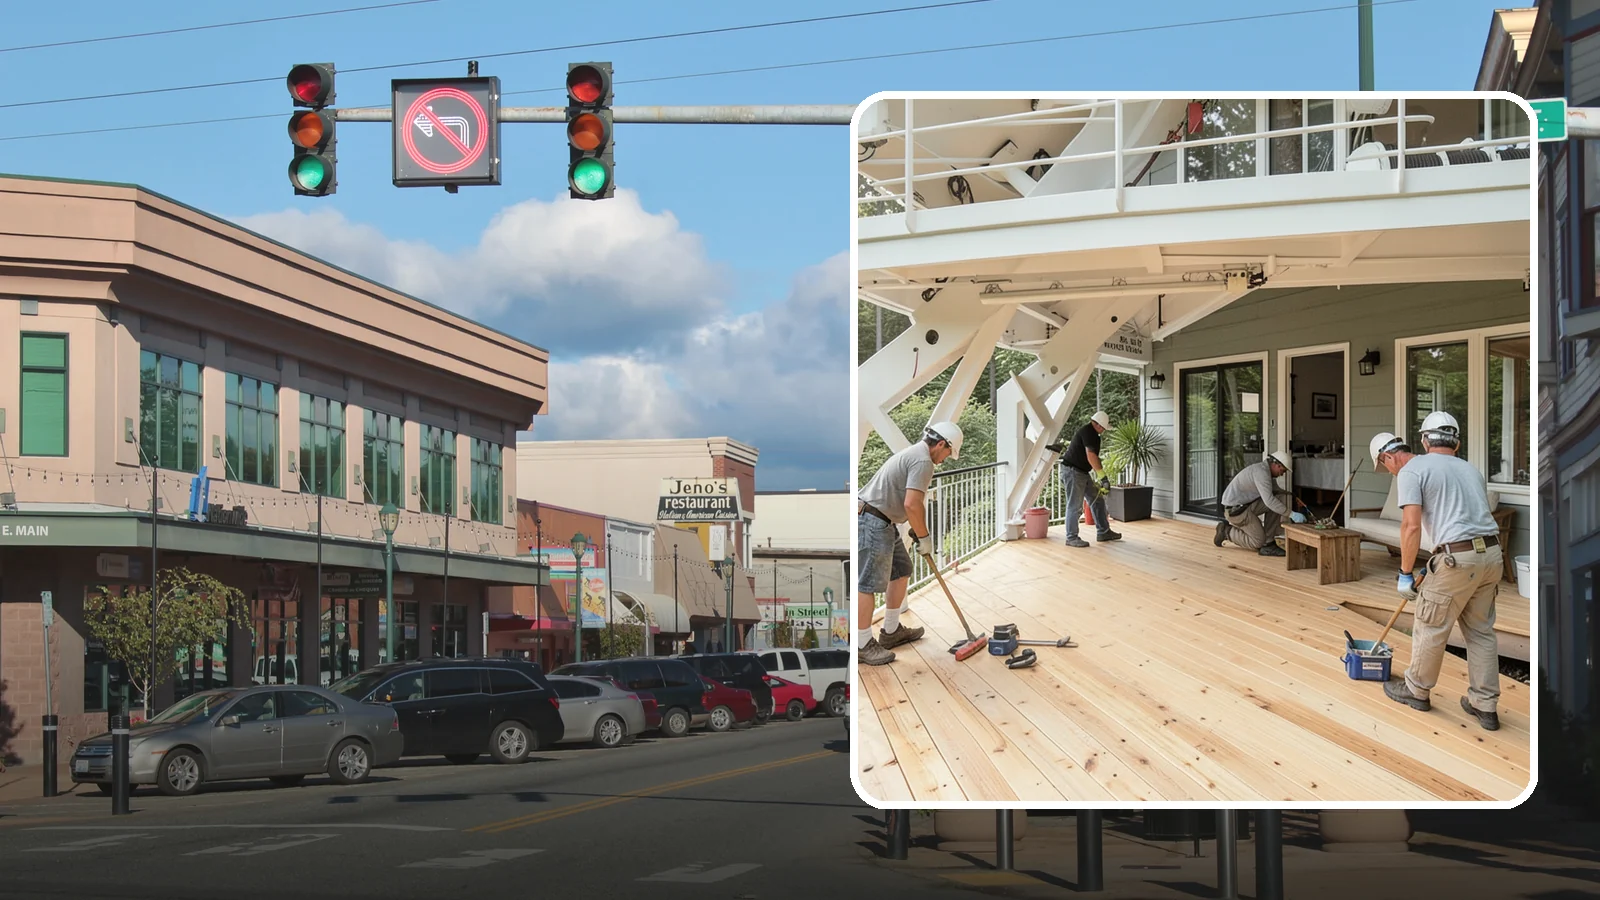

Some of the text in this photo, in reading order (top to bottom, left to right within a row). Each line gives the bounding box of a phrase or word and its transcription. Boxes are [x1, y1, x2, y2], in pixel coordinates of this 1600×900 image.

[669, 480, 727, 494] Jeno's
[665, 496, 731, 509] restaurant
[659, 510, 681, 519] Italian
[686, 510, 714, 519] American
[715, 510, 737, 519] Cuisine
[2, 525, 49, 536] E. MAIN
[797, 608, 828, 616] Street
[791, 619, 823, 627] lass
